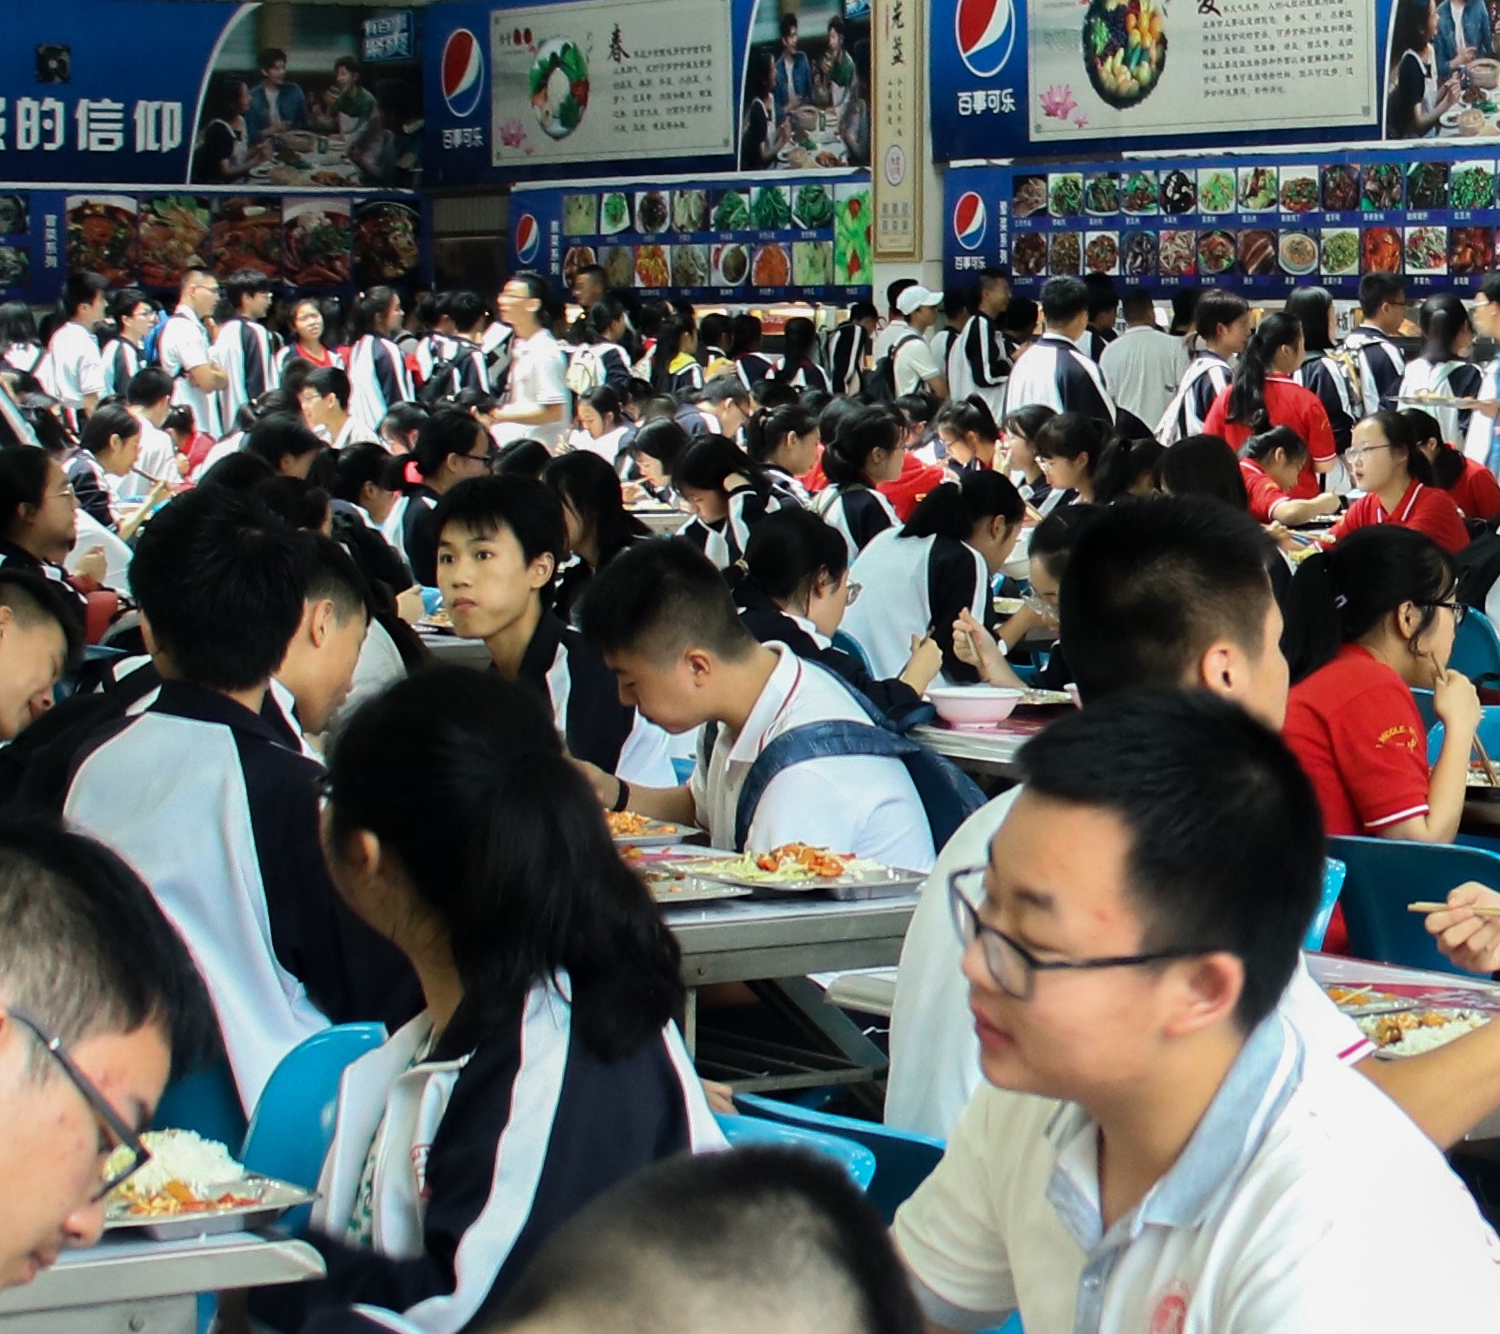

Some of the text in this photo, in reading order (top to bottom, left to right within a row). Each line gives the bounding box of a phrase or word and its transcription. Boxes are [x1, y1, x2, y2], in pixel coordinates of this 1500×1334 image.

[607, 23, 631, 64] 春
[957, 89, 1015, 115] 百事可乐
[442, 126, 484, 149] 百事可乐
